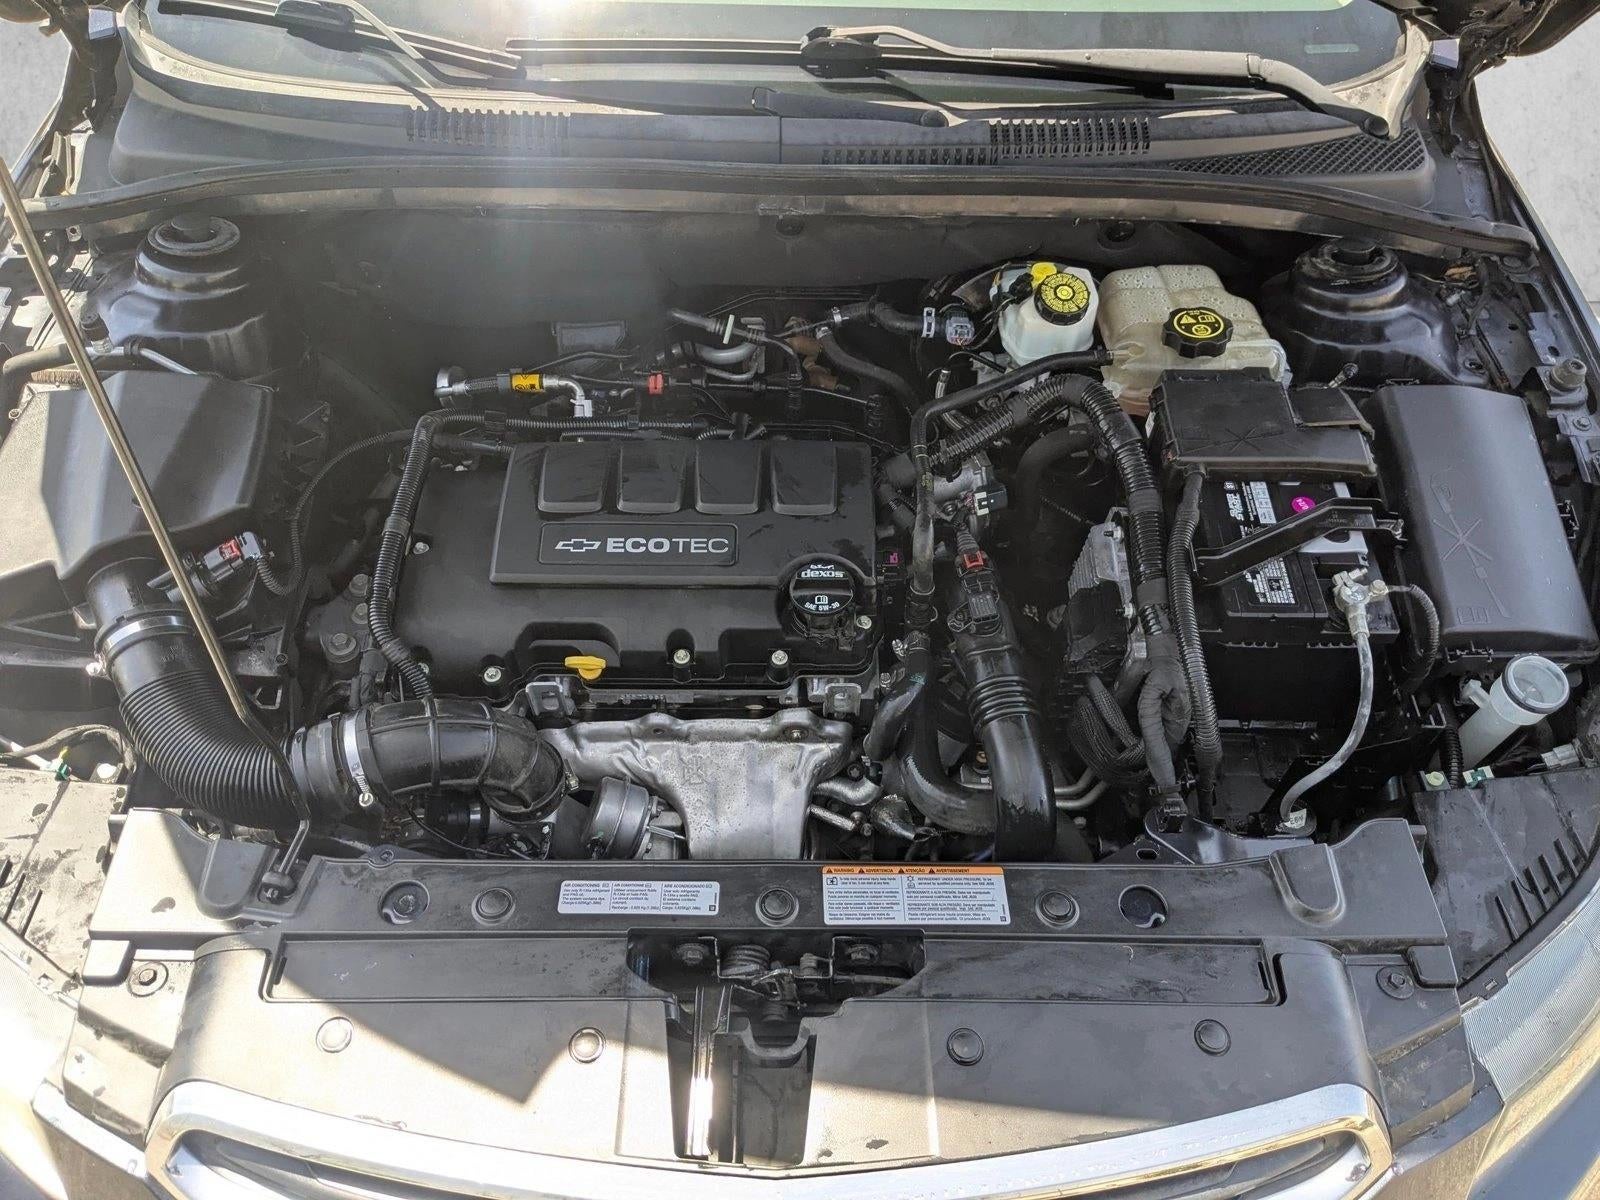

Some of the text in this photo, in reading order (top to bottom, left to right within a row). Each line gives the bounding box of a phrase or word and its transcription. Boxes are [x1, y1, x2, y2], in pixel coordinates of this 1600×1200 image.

[606, 537, 729, 554] ECOTEC
[801, 569, 845, 578] dexos
[804, 601, 840, 611] SAE 5W-30
